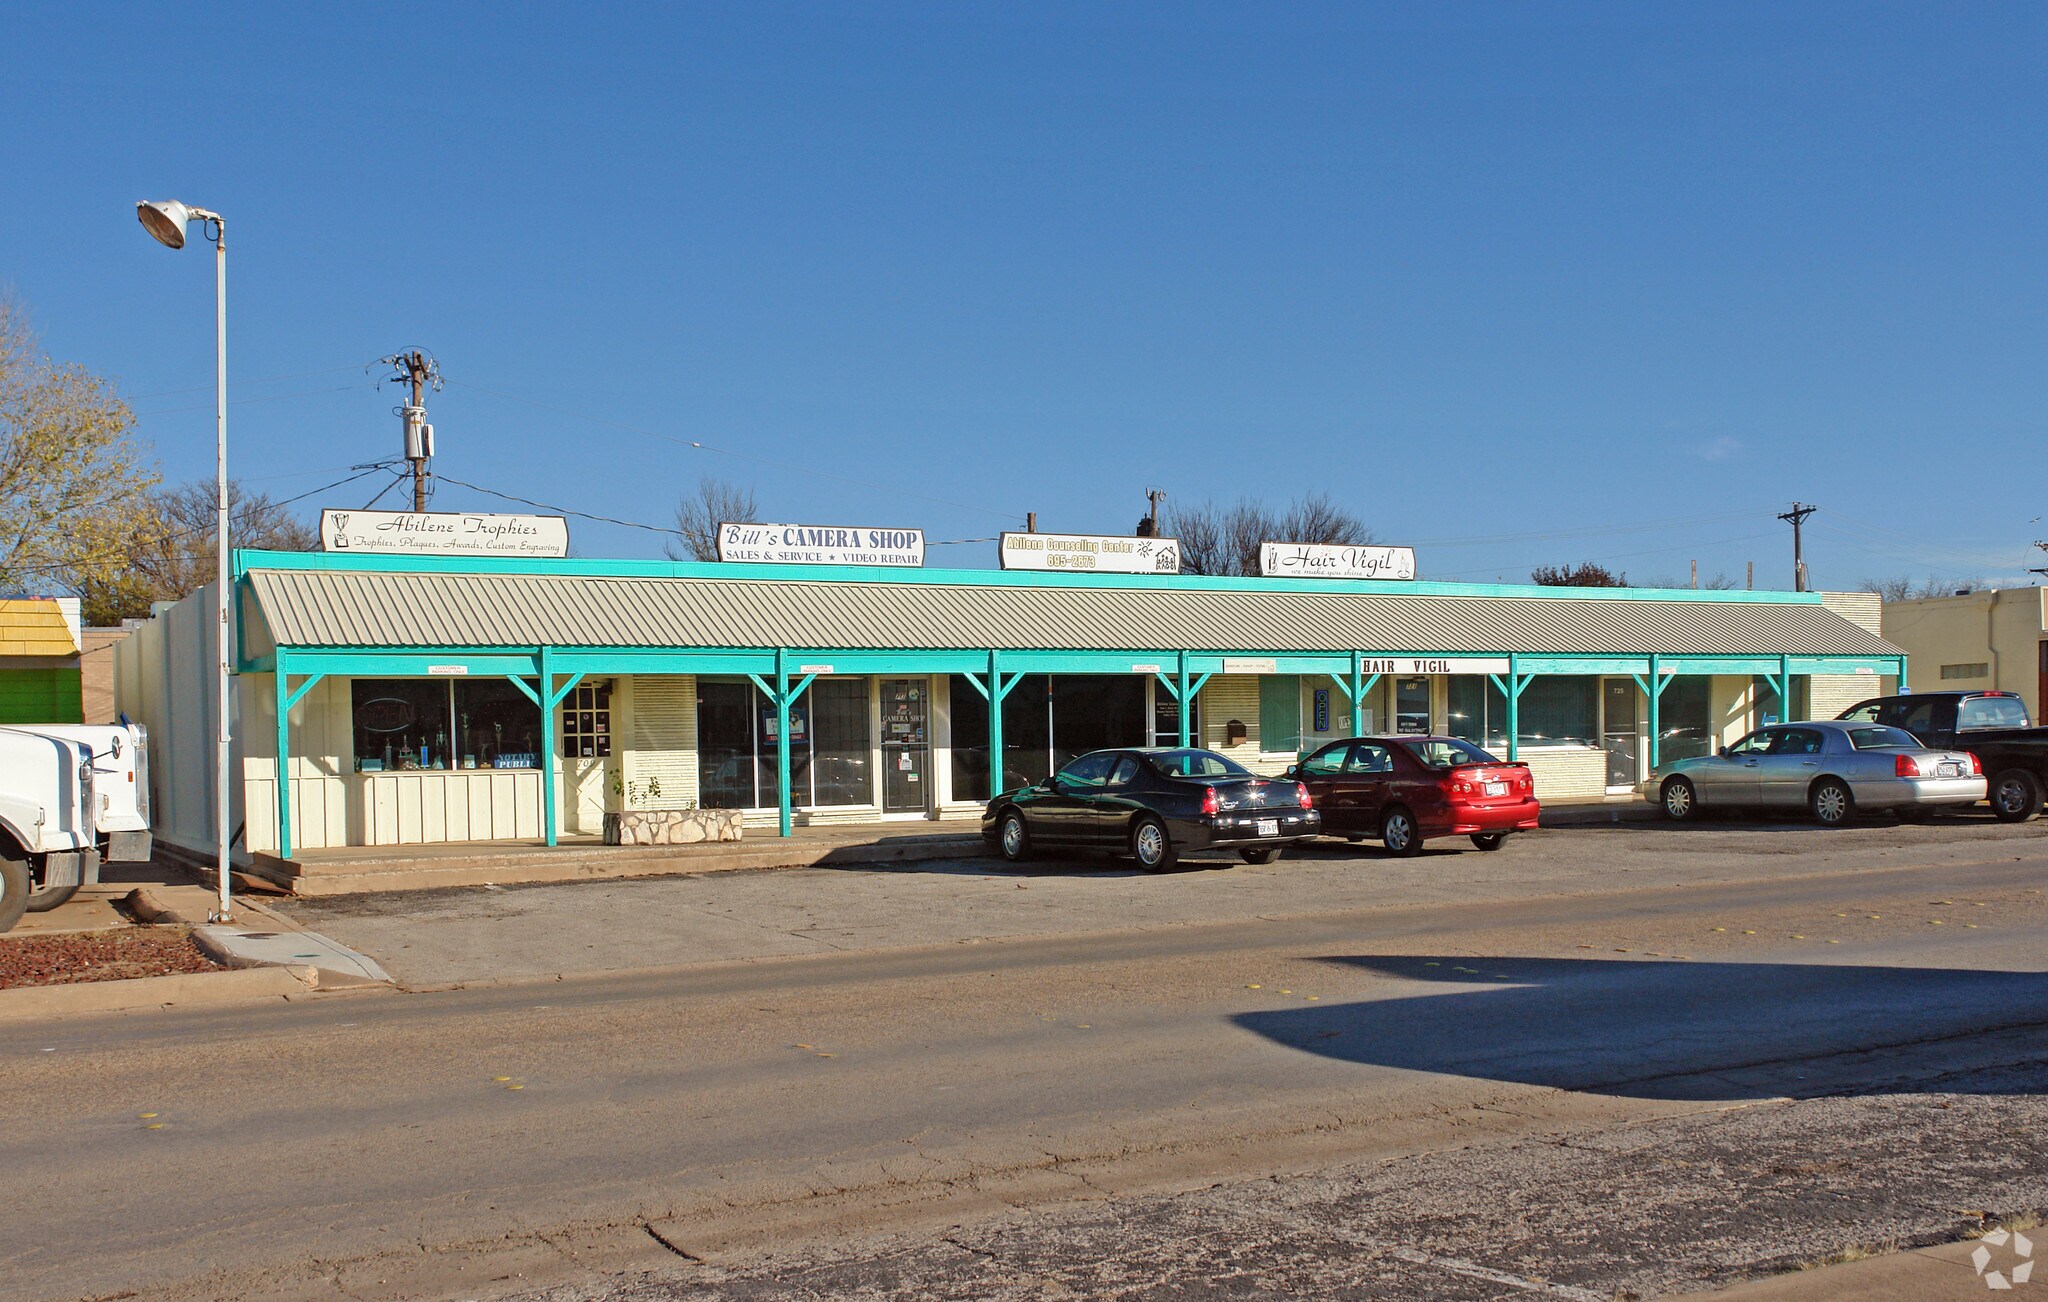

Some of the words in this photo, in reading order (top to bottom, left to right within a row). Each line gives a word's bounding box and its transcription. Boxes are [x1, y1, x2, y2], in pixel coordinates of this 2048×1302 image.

[376, 515, 454, 533] Abilene
[463, 517, 538, 540] Trophies
[354, 536, 396, 548] Trophies,
[400, 538, 439, 549] Plaques,
[443, 538, 483, 549] Awards,
[486, 540, 516, 550] Custom
[519, 541, 560, 554] Engraving
[726, 525, 778, 546] Bill's
[783, 528, 861, 548] CAMERA
[869, 531, 917, 549] SHOP
[1006, 537, 1043, 550] Abilene
[1047, 538, 1098, 554] Counseling
[1102, 540, 1134, 553] Center
[726, 550, 760, 560] SALES
[763, 551, 773, 560] &
[778, 551, 823, 562] SERVICE
[843, 553, 877, 563] VIDEO
[881, 554, 919, 564] REPAIR
[1282, 546, 1337, 569] Hair
[1341, 547, 1395, 577] Vigil
[1304, 567, 1325, 575] make
[1344, 568, 1363, 576] shine
[1363, 660, 1395, 673] HAIR
[1414, 660, 1451, 673] VIGIL
[1318, 693, 1326, 728] OPEN
[499, 760, 537, 768] PUBLIC
